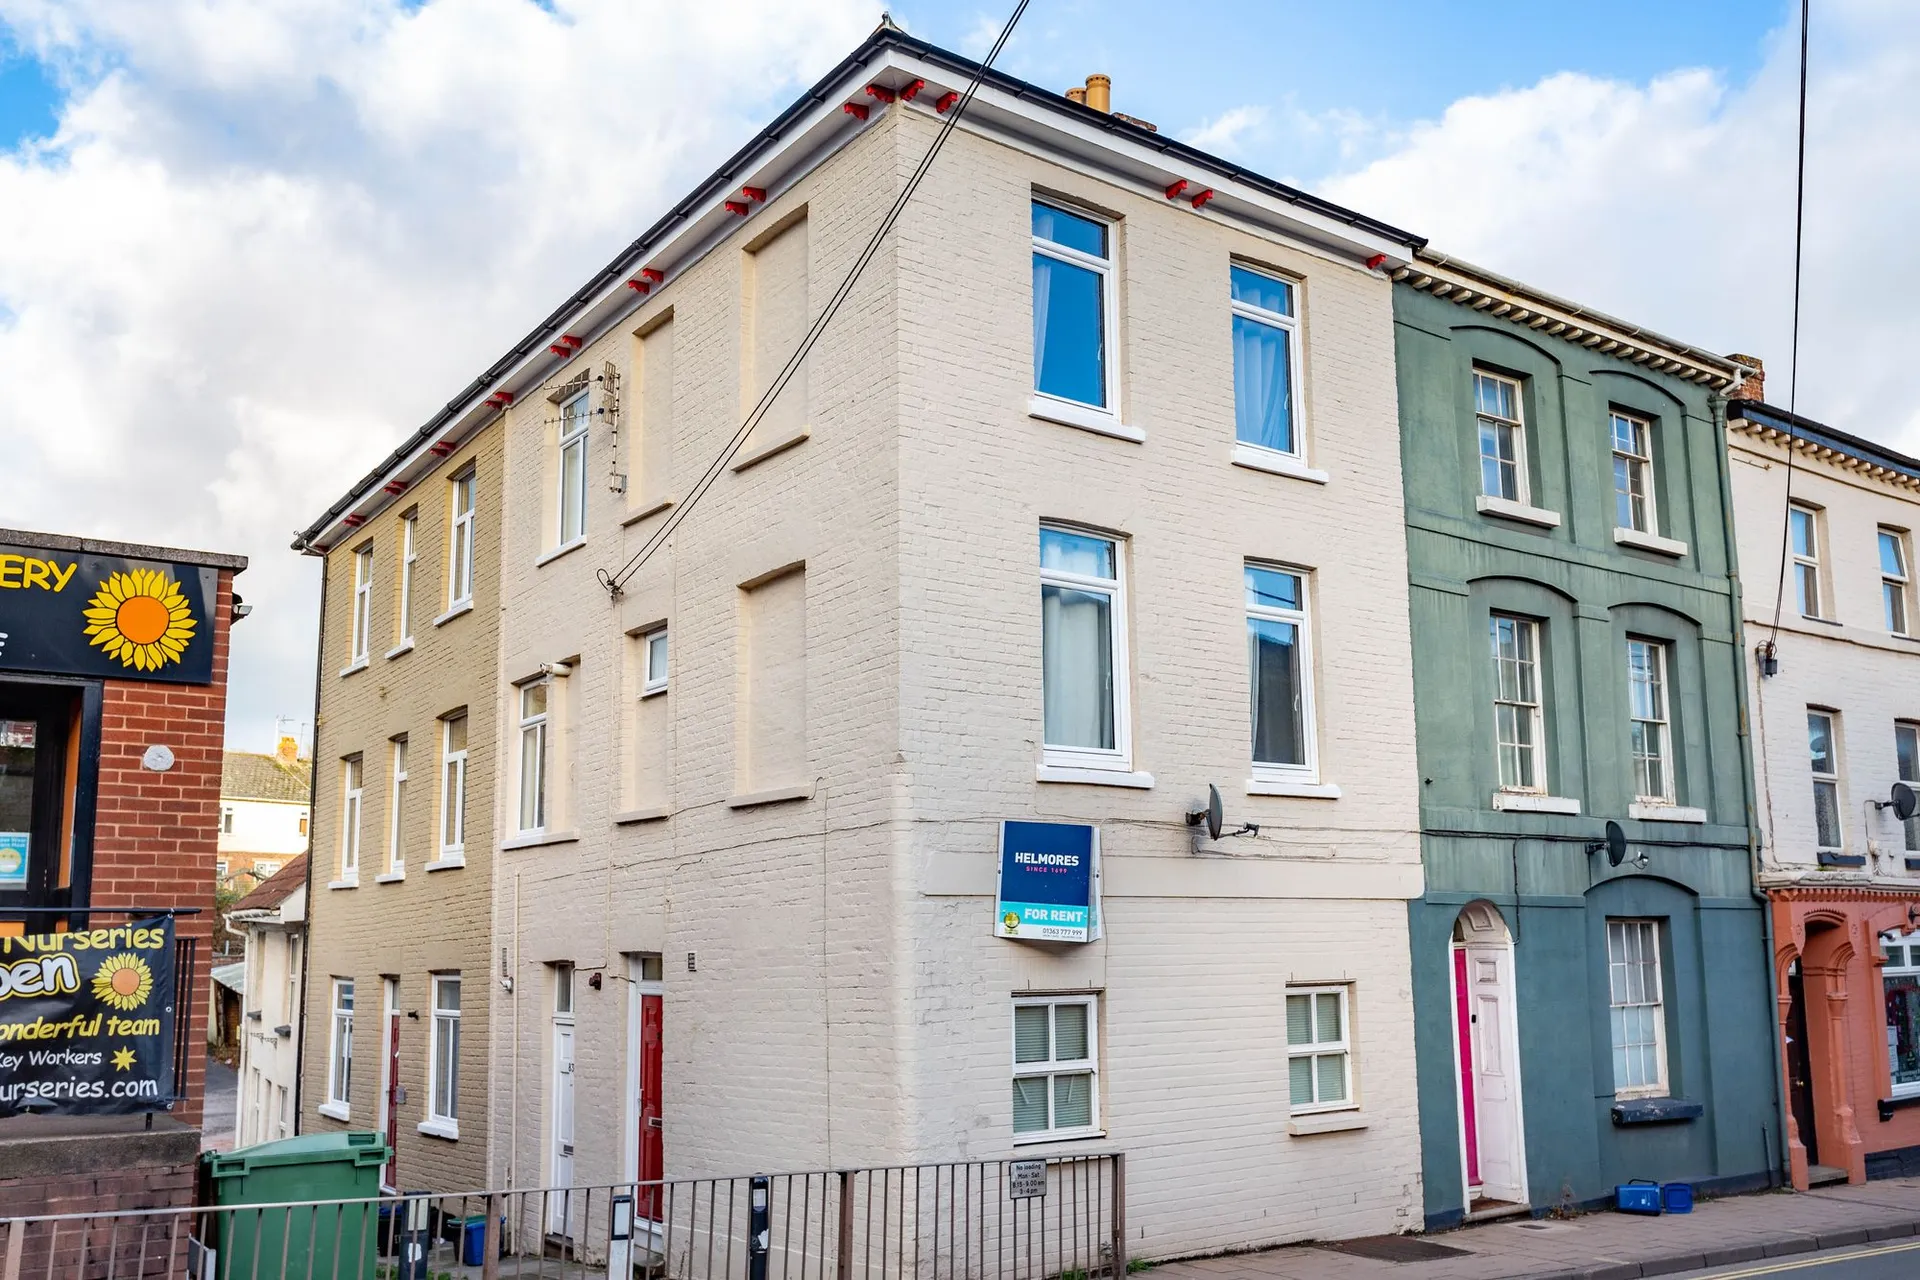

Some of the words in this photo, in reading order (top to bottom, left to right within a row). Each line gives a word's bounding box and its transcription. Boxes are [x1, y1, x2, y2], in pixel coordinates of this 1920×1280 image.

[1015, 852, 1079, 866] HELMORES
[1024, 908, 1048, 920] FOR
[1050, 909, 1083, 922] RENT
[4, 923, 164, 953] Nurseries
[107, 1015, 160, 1036] team
[29, 1048, 102, 1067] Workers
